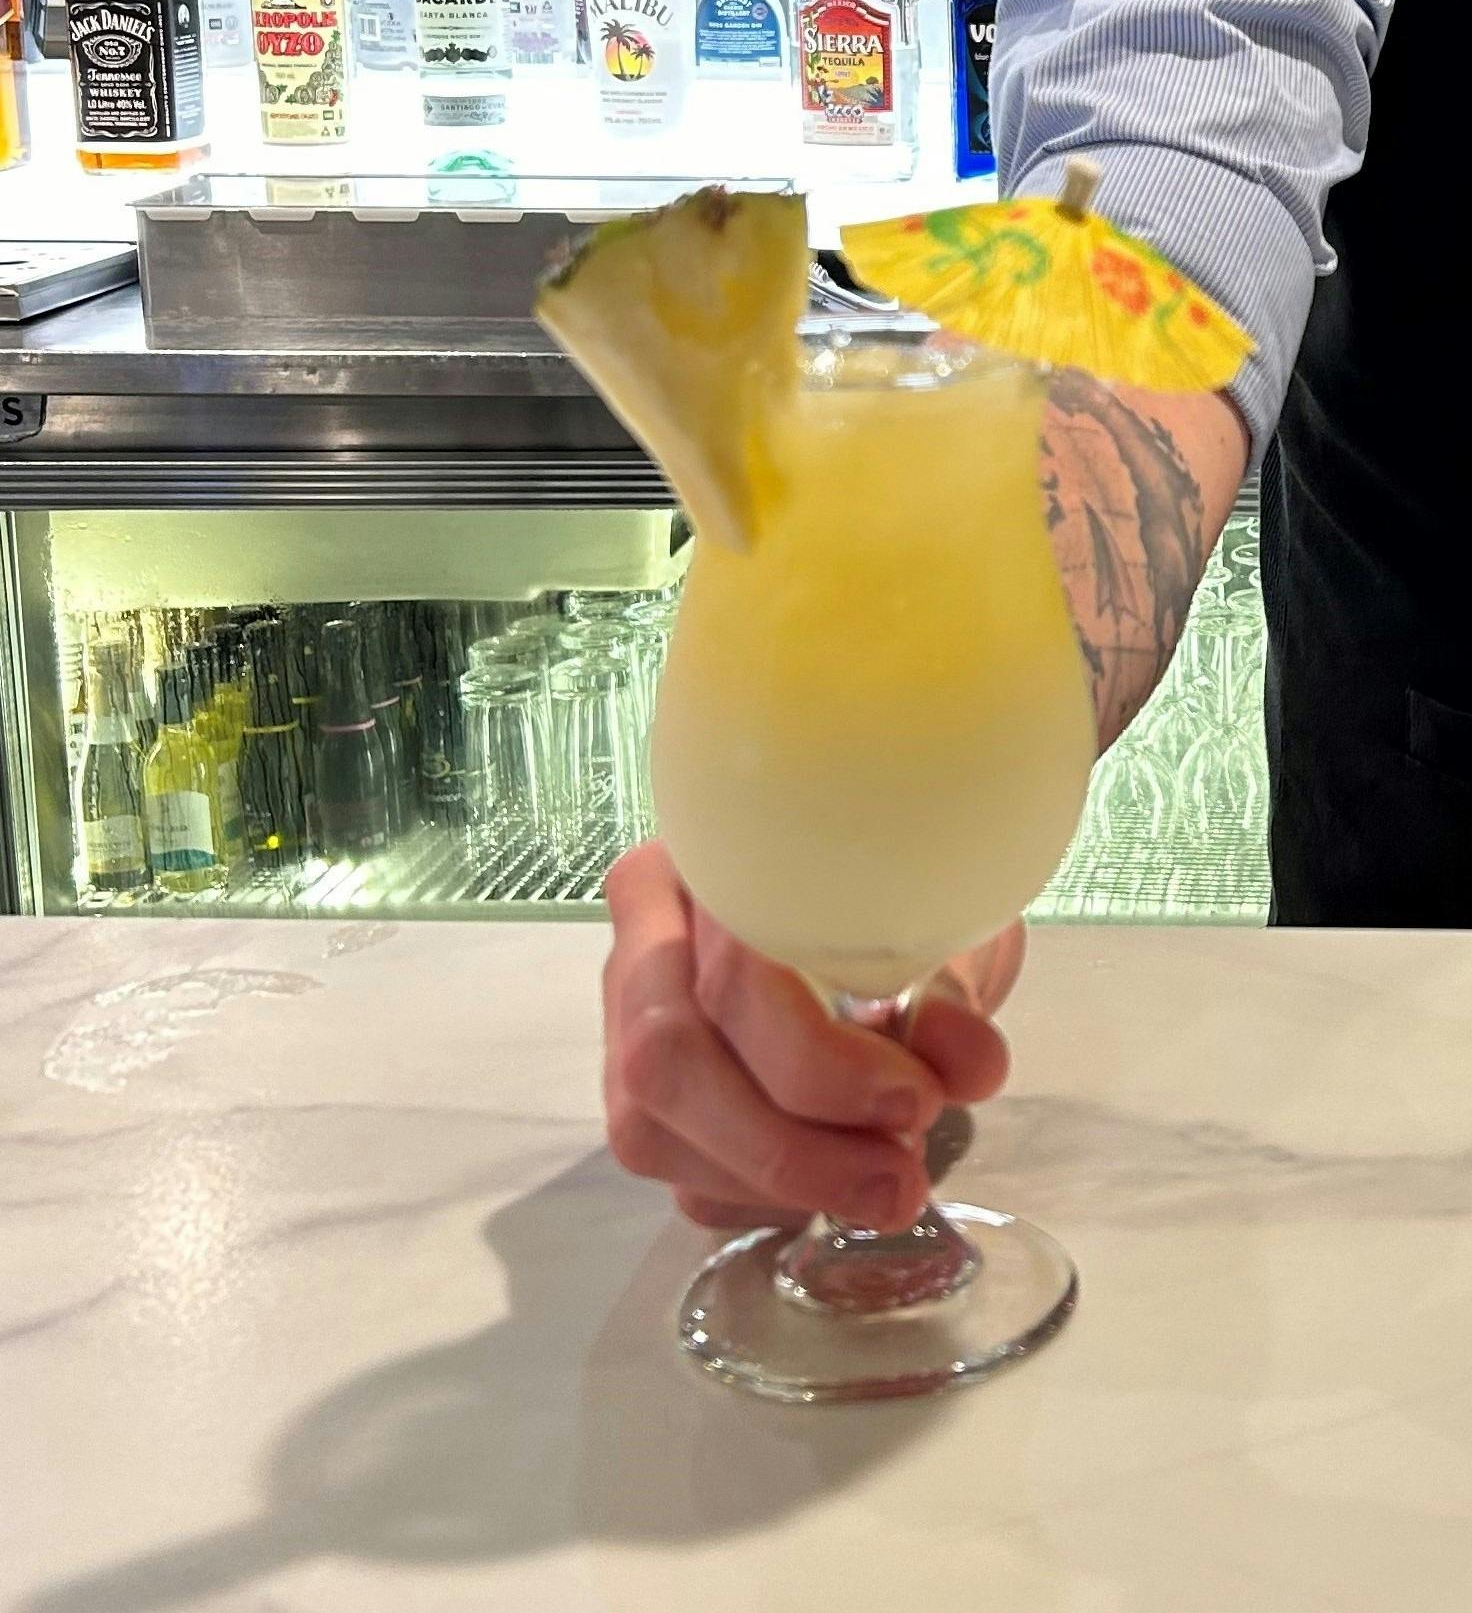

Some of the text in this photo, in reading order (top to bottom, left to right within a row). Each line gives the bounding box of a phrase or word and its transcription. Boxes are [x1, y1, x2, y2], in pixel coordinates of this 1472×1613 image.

[449, 11, 488, 19] BLANCA
[70, 9, 155, 44] JACK DANIEL'S
[804, 26, 885, 55] SIERRA
[822, 57, 865, 66] TEQUILA
[87, 68, 142, 81] Tennessee
[89, 88, 143, 98] WHISKEY
